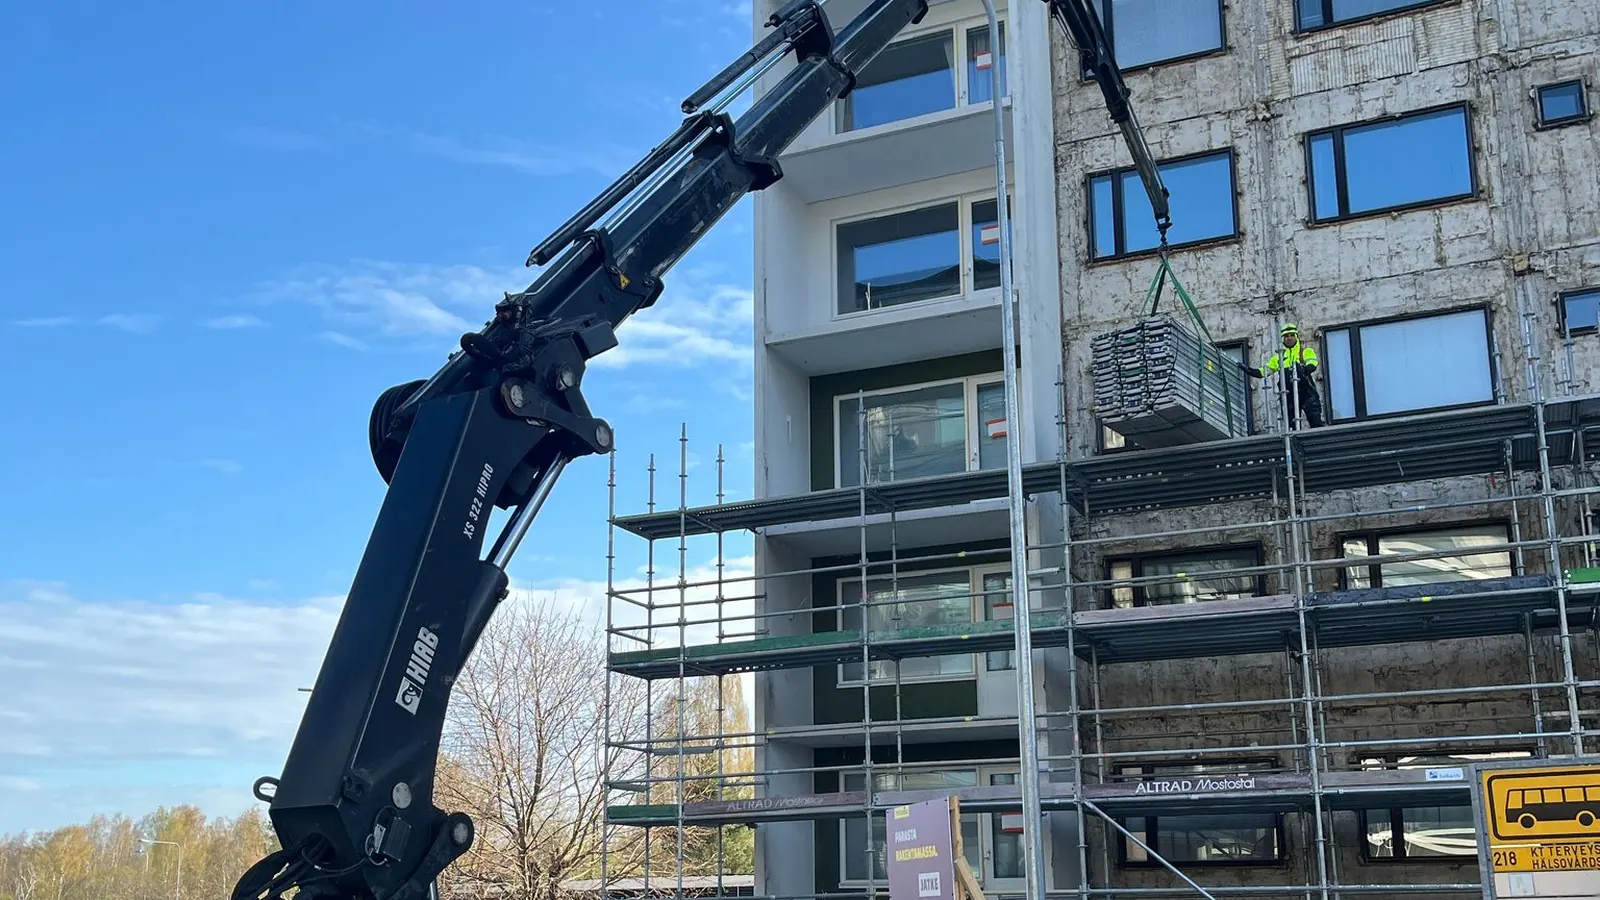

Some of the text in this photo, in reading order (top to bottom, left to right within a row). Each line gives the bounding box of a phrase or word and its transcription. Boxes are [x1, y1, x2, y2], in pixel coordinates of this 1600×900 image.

[463, 463, 494, 539] XS 322 HIPRO
[405, 626, 439, 686] HIAB
[1135, 777, 1255, 794] ALTRAD Mostostal
[727, 799, 773, 812] ALTRAD
[1493, 851, 1517, 867] 218
[1548, 844, 1600, 856] TERVEYS
